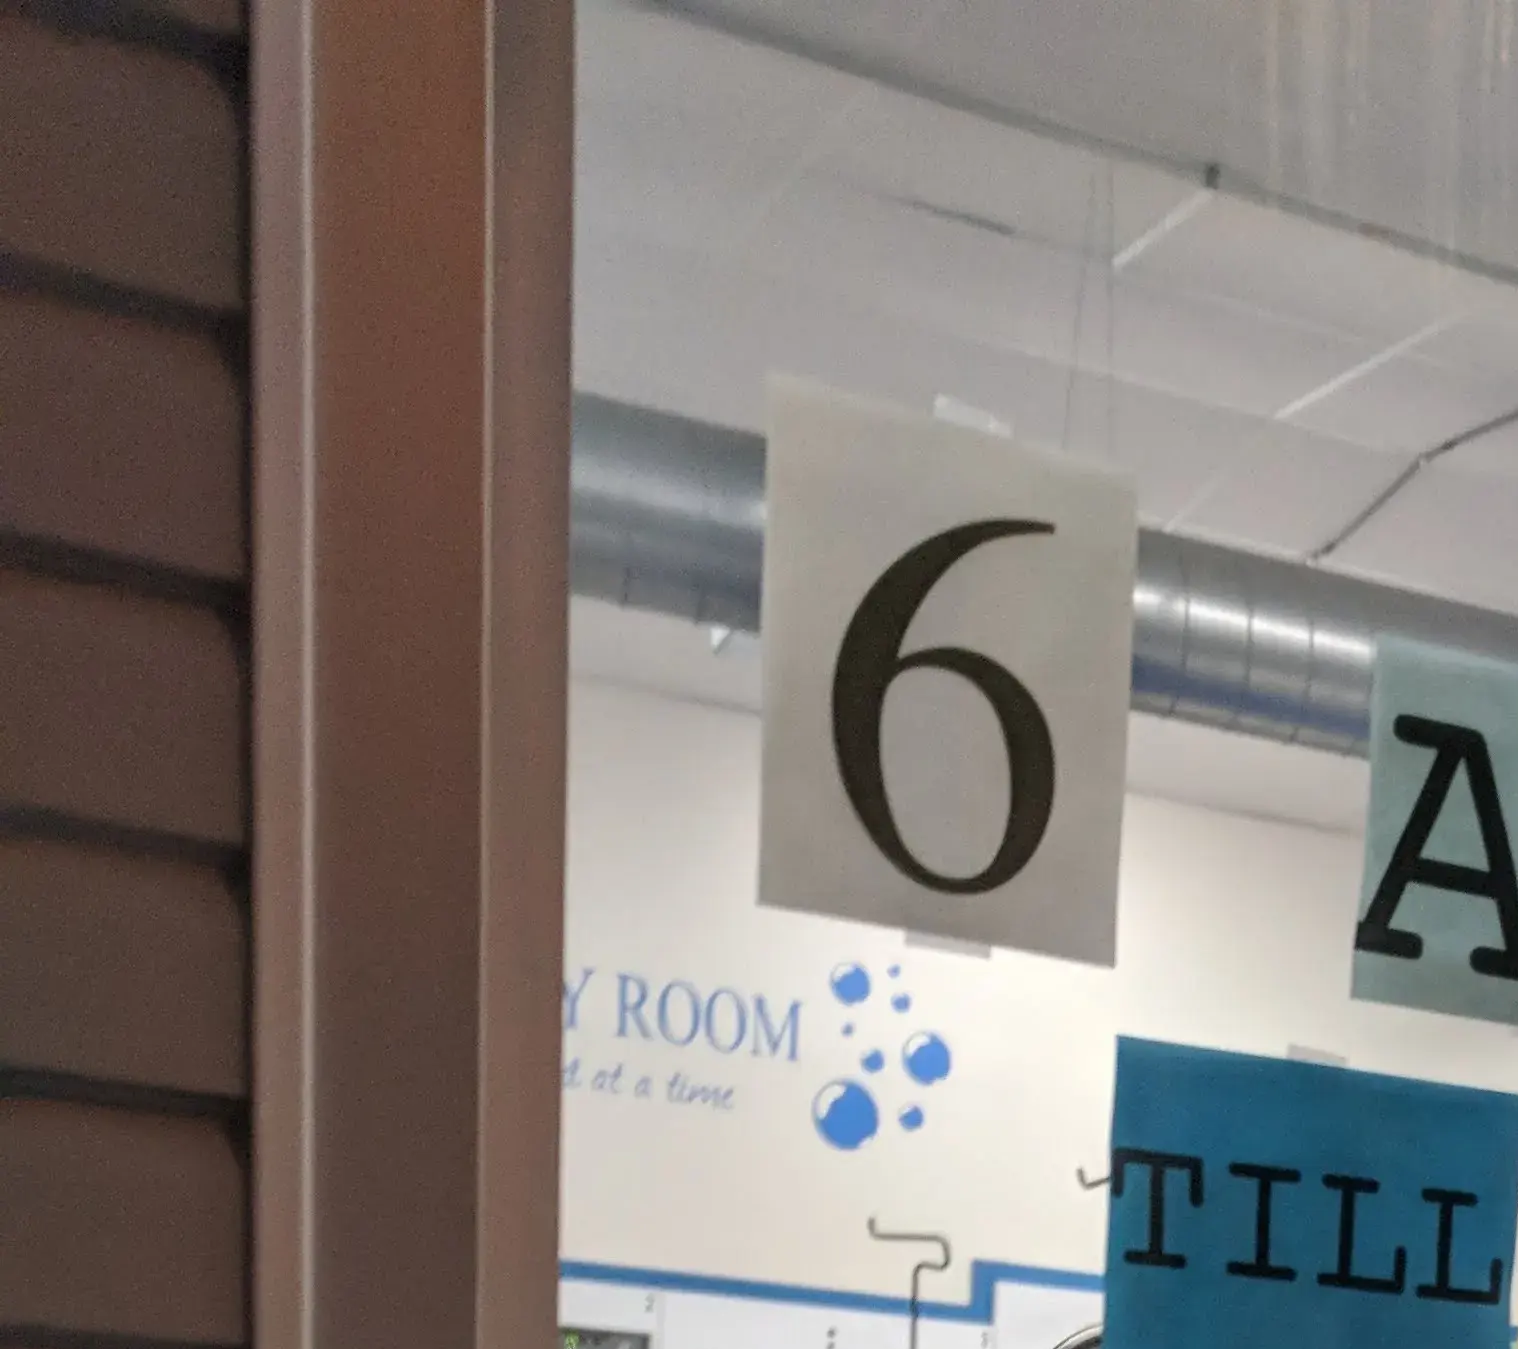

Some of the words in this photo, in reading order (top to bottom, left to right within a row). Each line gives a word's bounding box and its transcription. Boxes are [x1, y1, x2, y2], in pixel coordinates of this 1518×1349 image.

[831, 516, 1057, 896] 6
[616, 970, 802, 1062] ROOM
[667, 1071, 735, 1110] time
[1110, 1146, 1504, 1306] TILL
